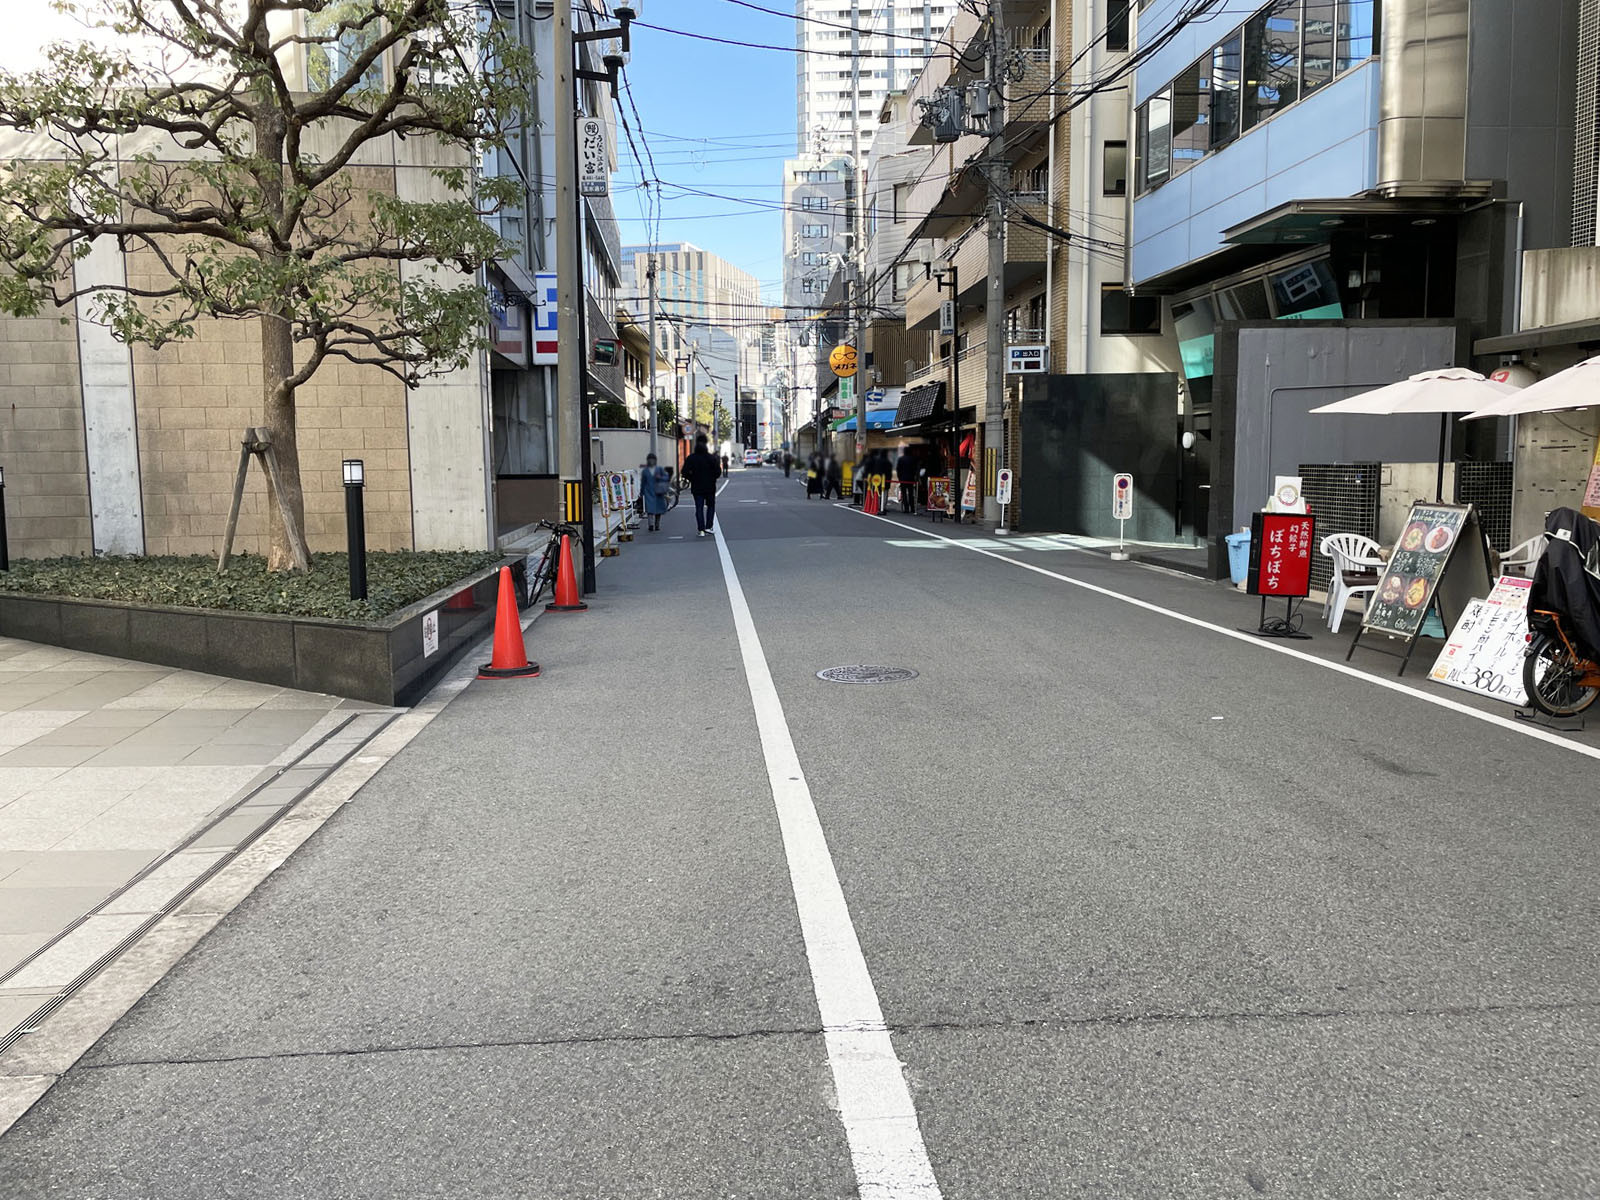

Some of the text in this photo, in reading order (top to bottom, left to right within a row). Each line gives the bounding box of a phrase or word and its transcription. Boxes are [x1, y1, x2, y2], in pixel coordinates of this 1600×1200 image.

[584, 136, 597, 175] だい富
[834, 362, 857, 371] メガネ
[1298, 521, 1310, 558] 天然鮮魚
[1267, 528, 1285, 590] ぼちぼち
